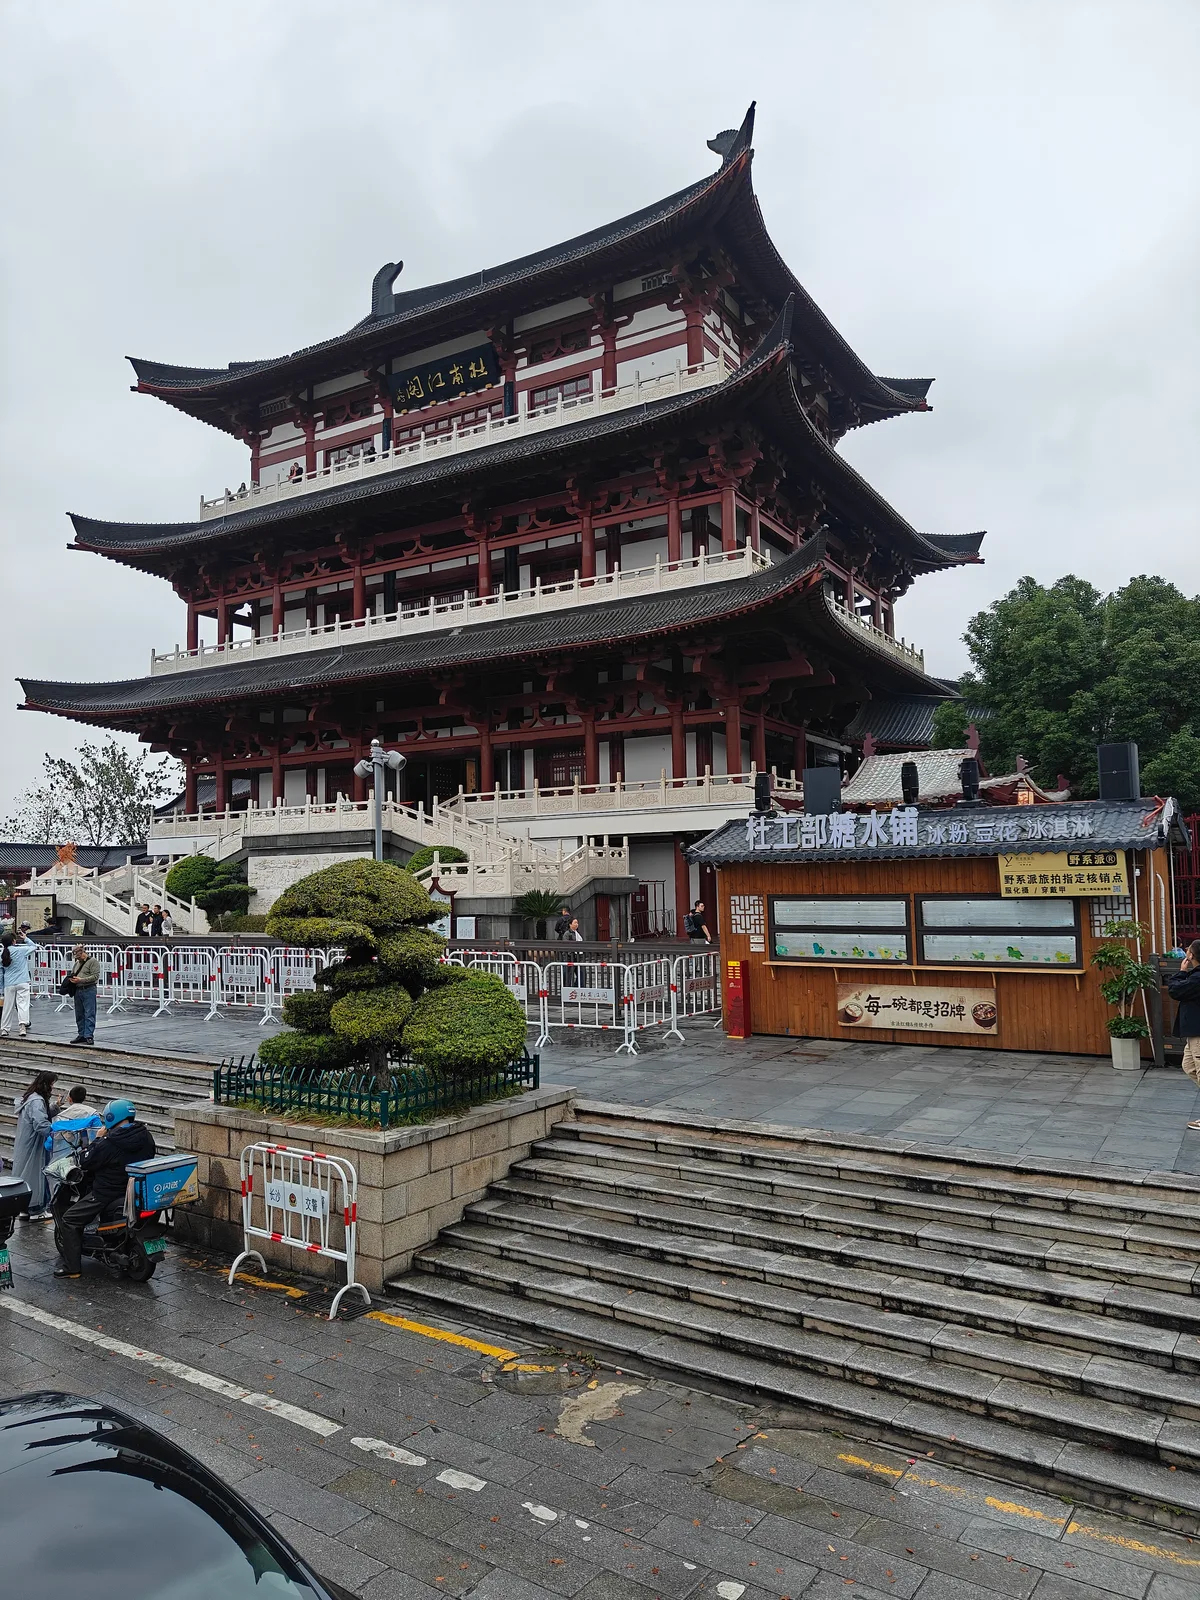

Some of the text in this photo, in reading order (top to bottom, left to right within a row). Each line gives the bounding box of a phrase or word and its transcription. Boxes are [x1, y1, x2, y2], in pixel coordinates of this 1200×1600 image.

[745, 806, 1094, 850] 杜工部糖水铺 冰粉 豆花 冰淇淋
[1003, 872, 1124, 885] 野系派旅拍指定核销点
[864, 993, 967, 1021] 每一碗都是招牌
[269, 1187, 281, 1203] 长沙
[305, 1196, 318, 1213] 交警
